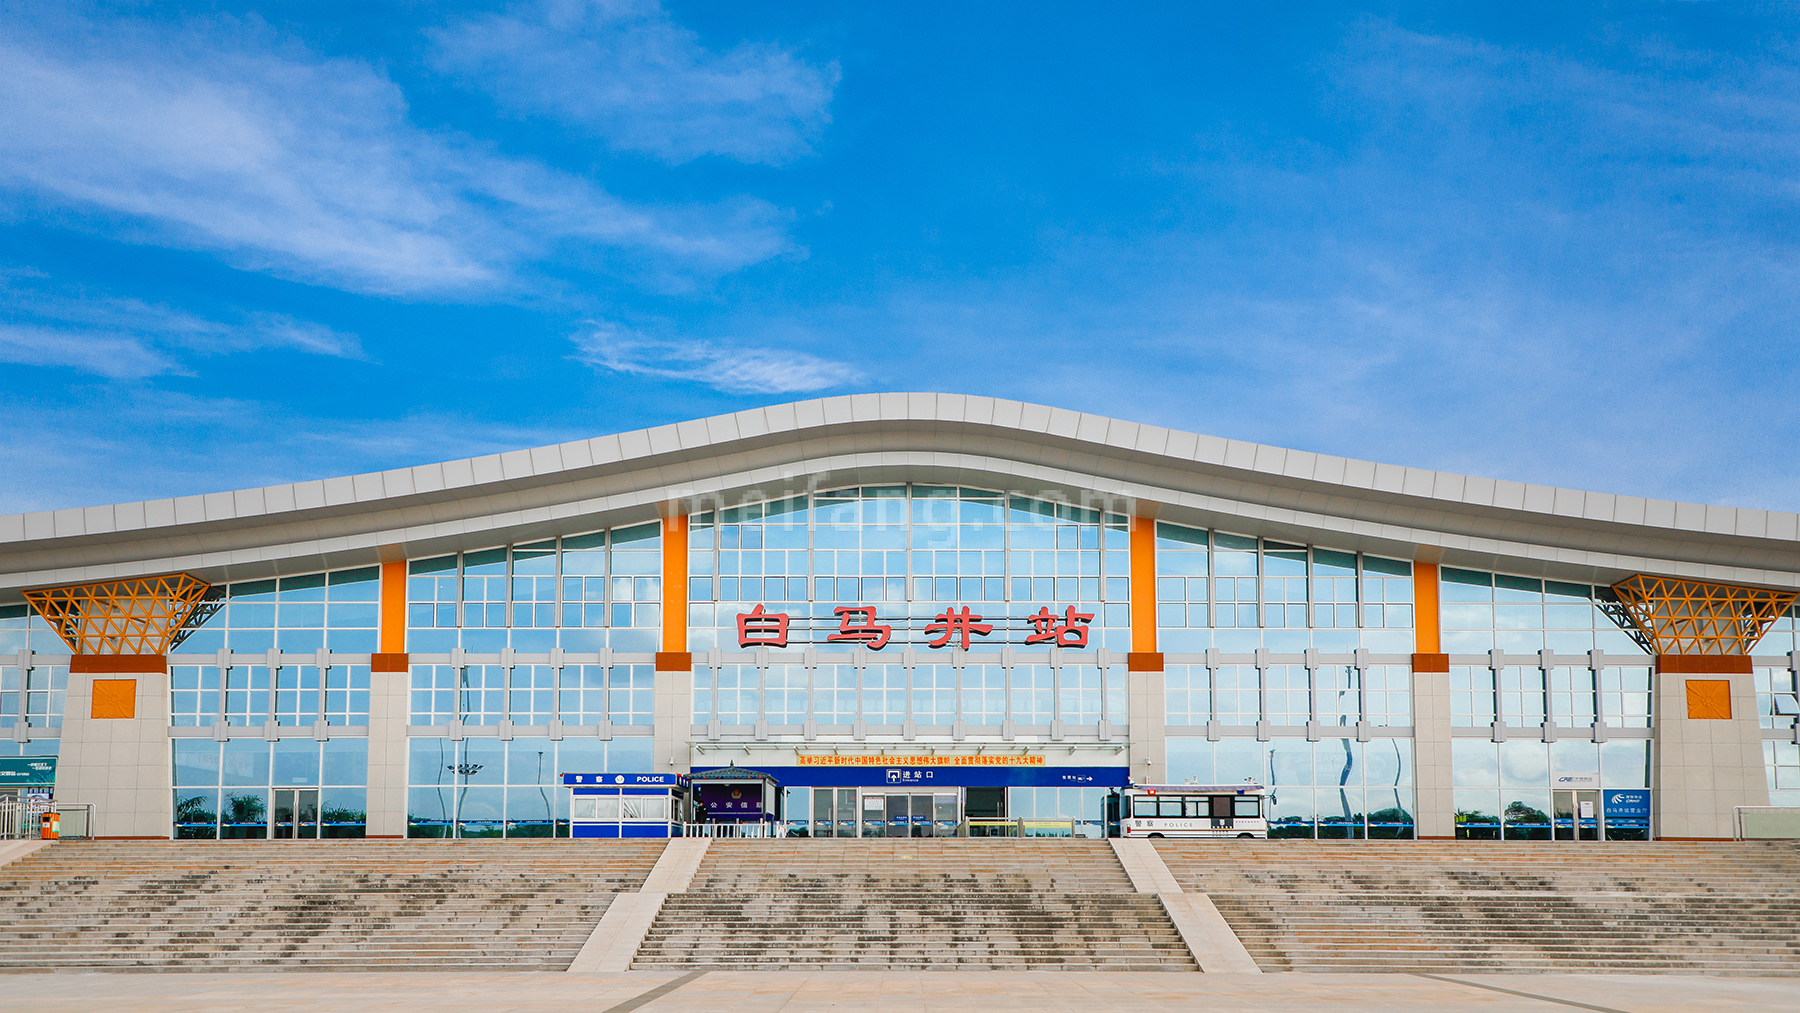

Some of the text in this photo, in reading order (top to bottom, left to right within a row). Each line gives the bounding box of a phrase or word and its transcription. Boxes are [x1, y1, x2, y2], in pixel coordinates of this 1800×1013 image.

[736, 603, 1095, 650] 白马井站
[799, 756, 1043, 765] 高举习近平新时代中国特色社会主义思想伟大旗帜 全面贯彻落实党的十九大精神
[636, 775, 665, 783] POLICE
[902, 770, 934, 779] 进站口
